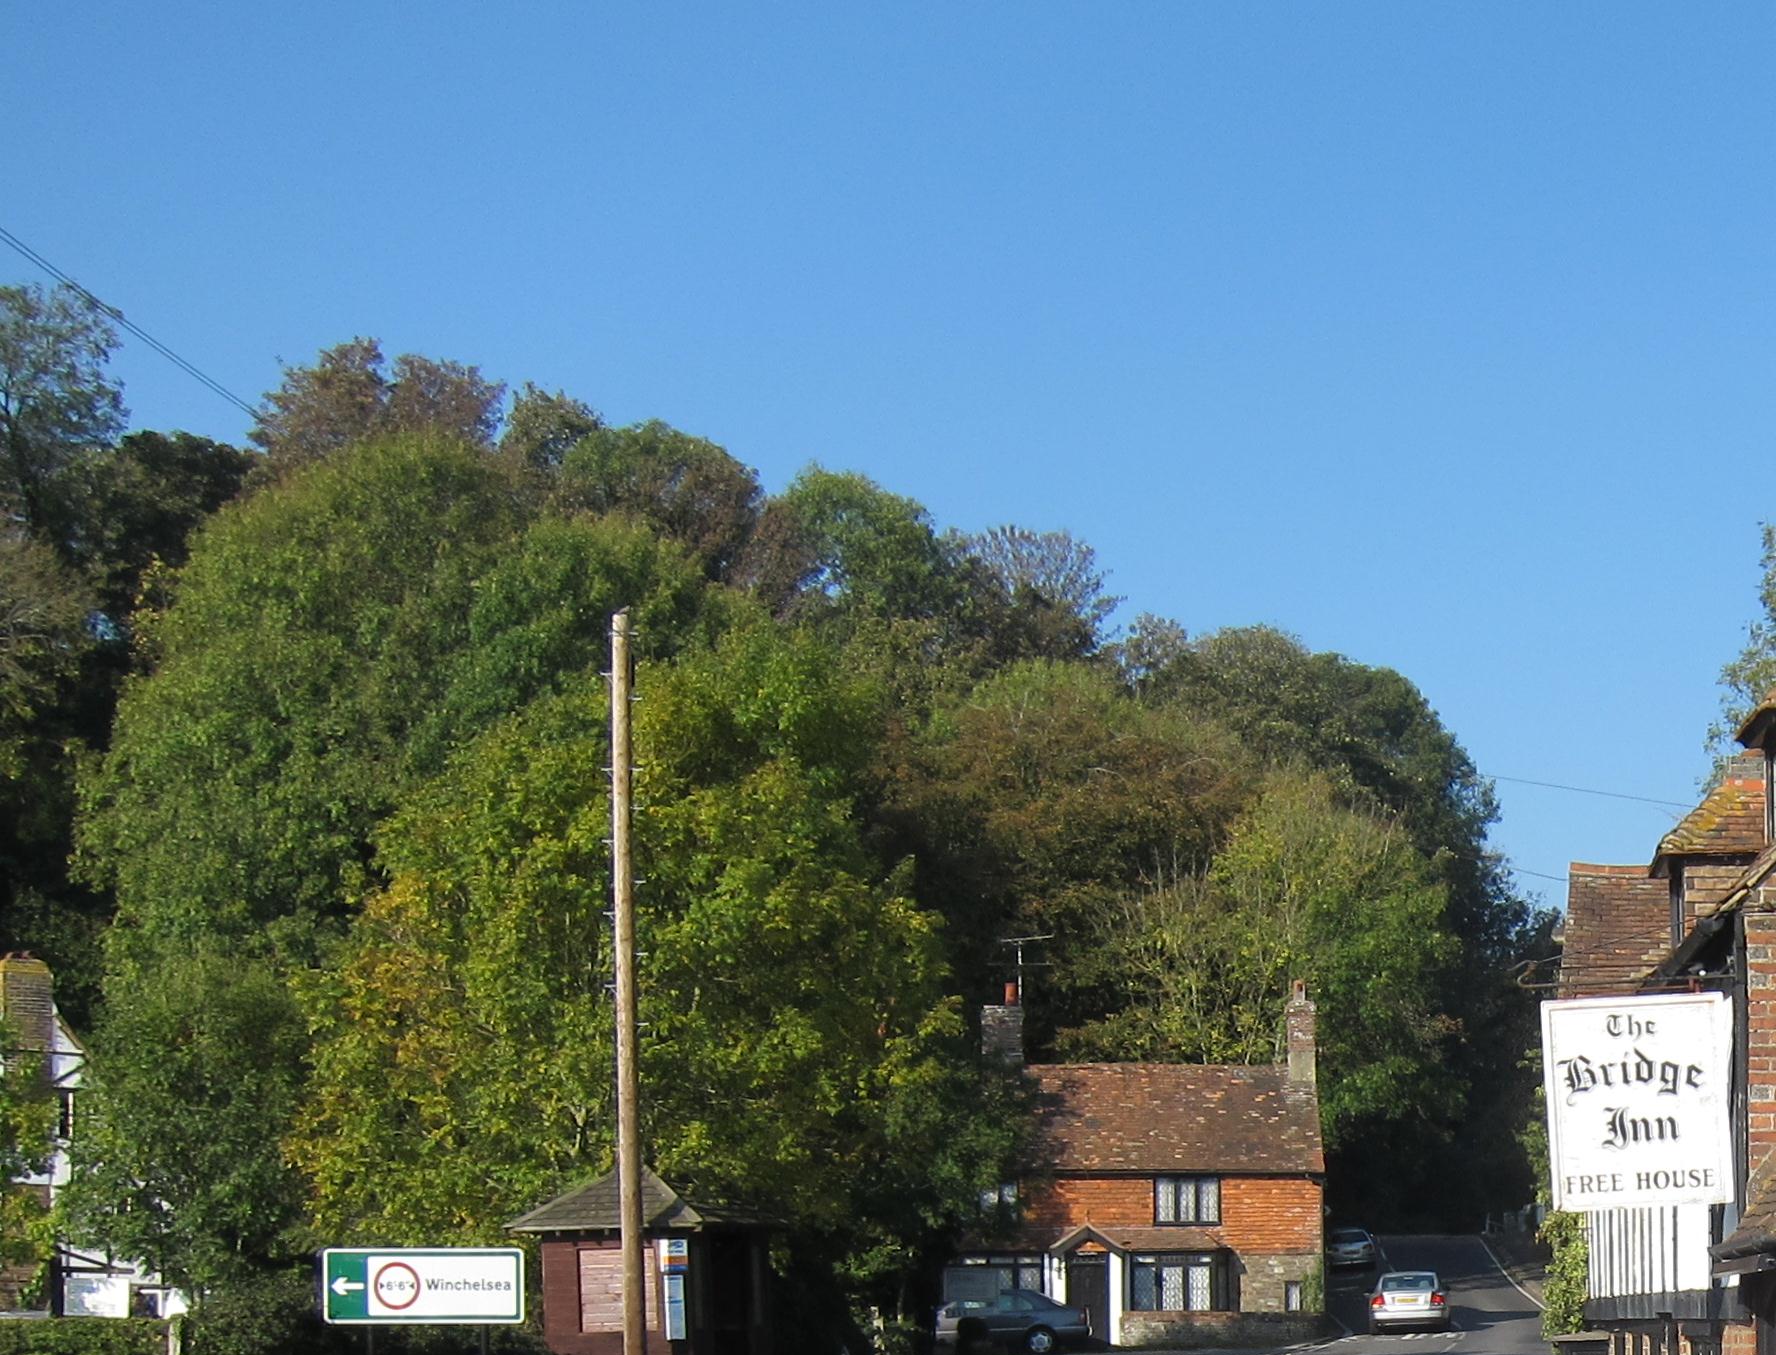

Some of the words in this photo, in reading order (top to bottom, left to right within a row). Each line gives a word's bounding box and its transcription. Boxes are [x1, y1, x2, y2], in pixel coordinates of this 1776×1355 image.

[1606, 1014, 1656, 1041] The
[1557, 1047, 1704, 1106] Bridge
[1602, 1107, 1680, 1150] Inn
[1566, 1173, 1624, 1194] FREE
[1636, 1168, 1715, 1190] HOUSE
[425, 1278, 512, 1291] Winchelsea
